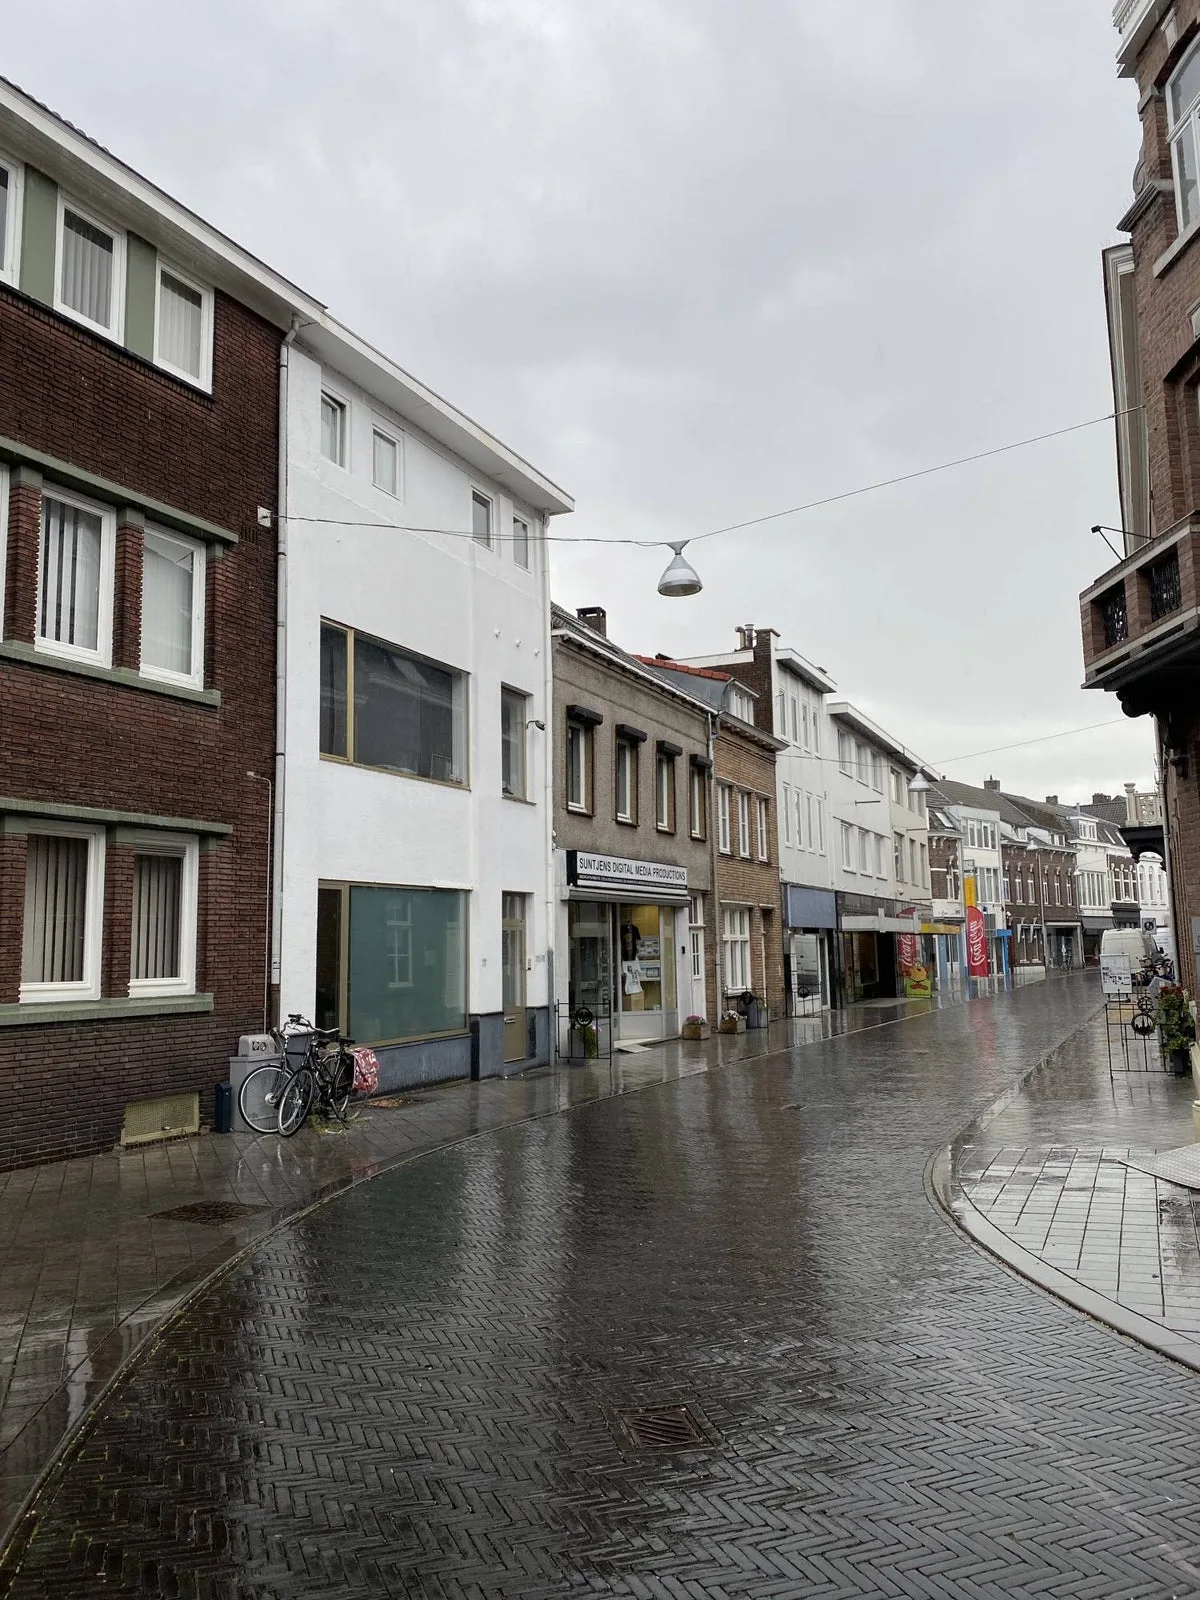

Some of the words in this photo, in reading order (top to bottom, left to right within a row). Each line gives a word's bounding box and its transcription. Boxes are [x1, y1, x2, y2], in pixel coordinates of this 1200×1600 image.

[579, 857, 612, 872] SUNTJENS
[612, 861, 634, 875] DIGITAL
[635, 865, 652, 877] MEDIA
[652, 867, 686, 881] PRODUCTIONS
